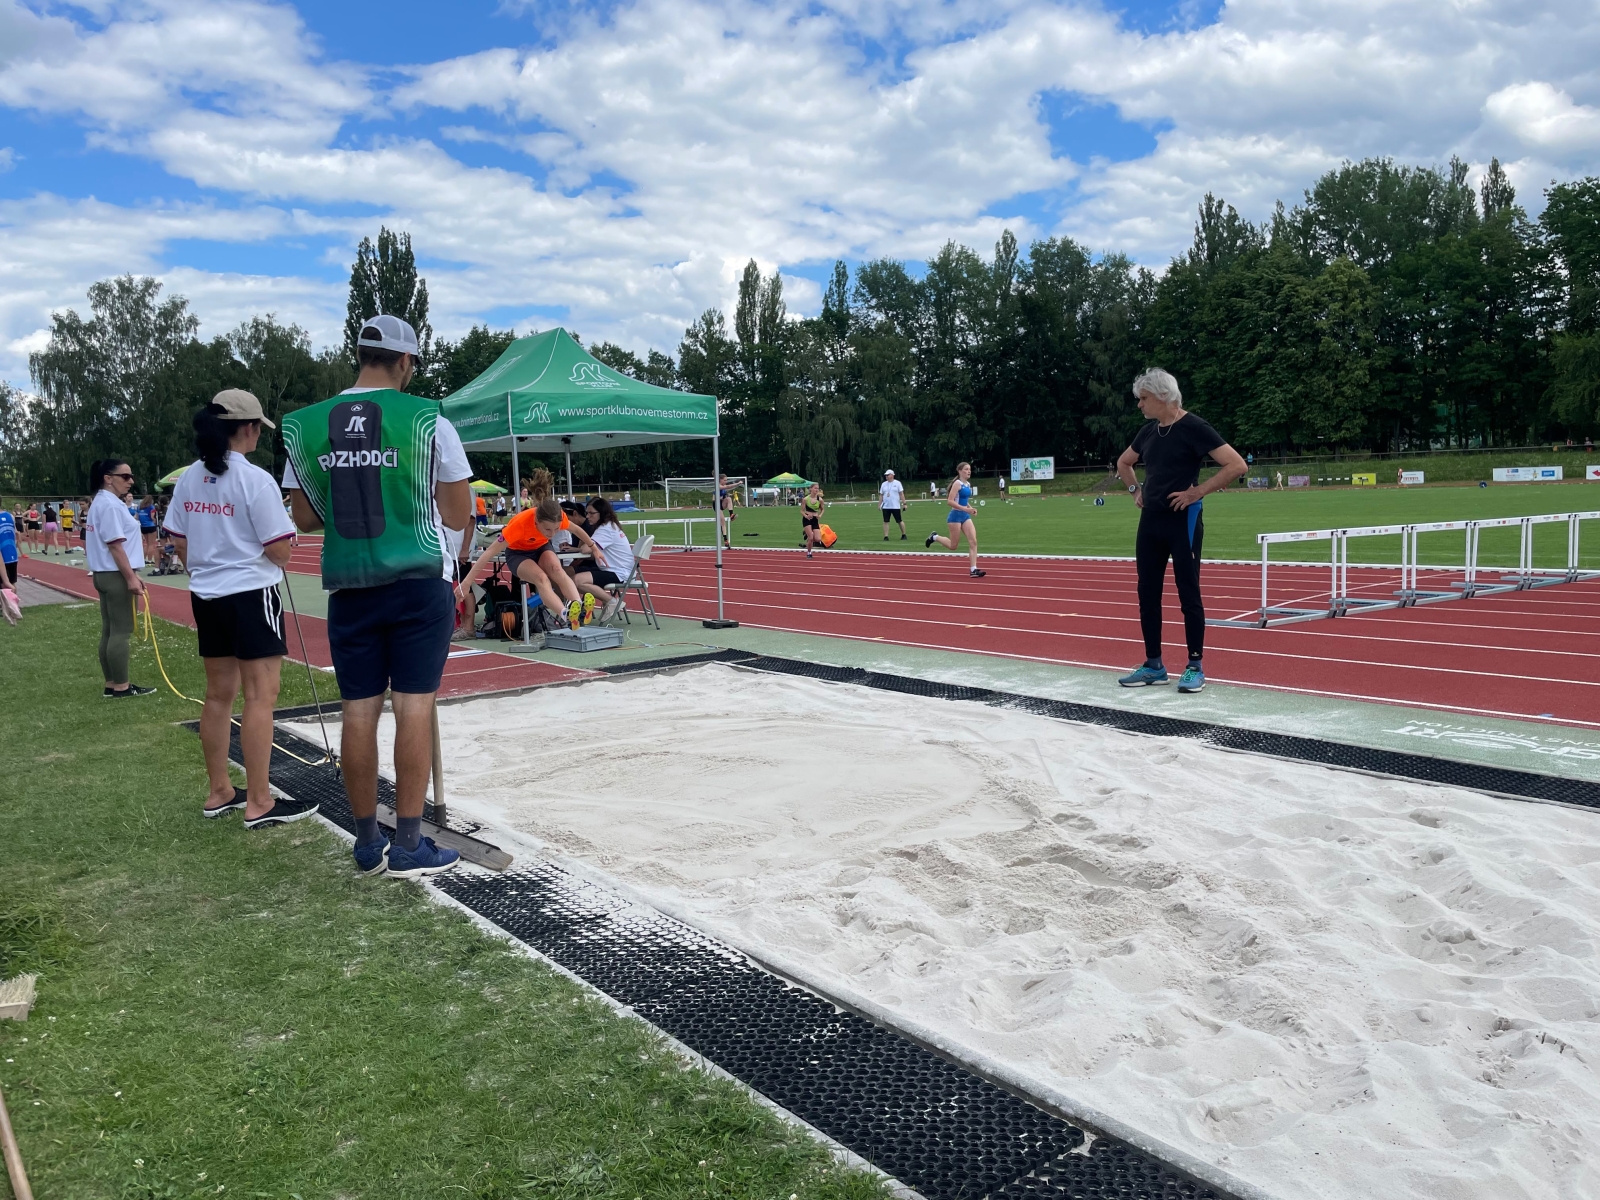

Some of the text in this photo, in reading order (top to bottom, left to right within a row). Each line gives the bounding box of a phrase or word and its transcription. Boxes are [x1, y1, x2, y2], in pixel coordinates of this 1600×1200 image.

[558, 404, 708, 420] www.sportklubnovemestonm.cz
[317, 447, 398, 472] ROZHODČÍ
[1406, 720, 1600, 748] ONSTRUCTION
